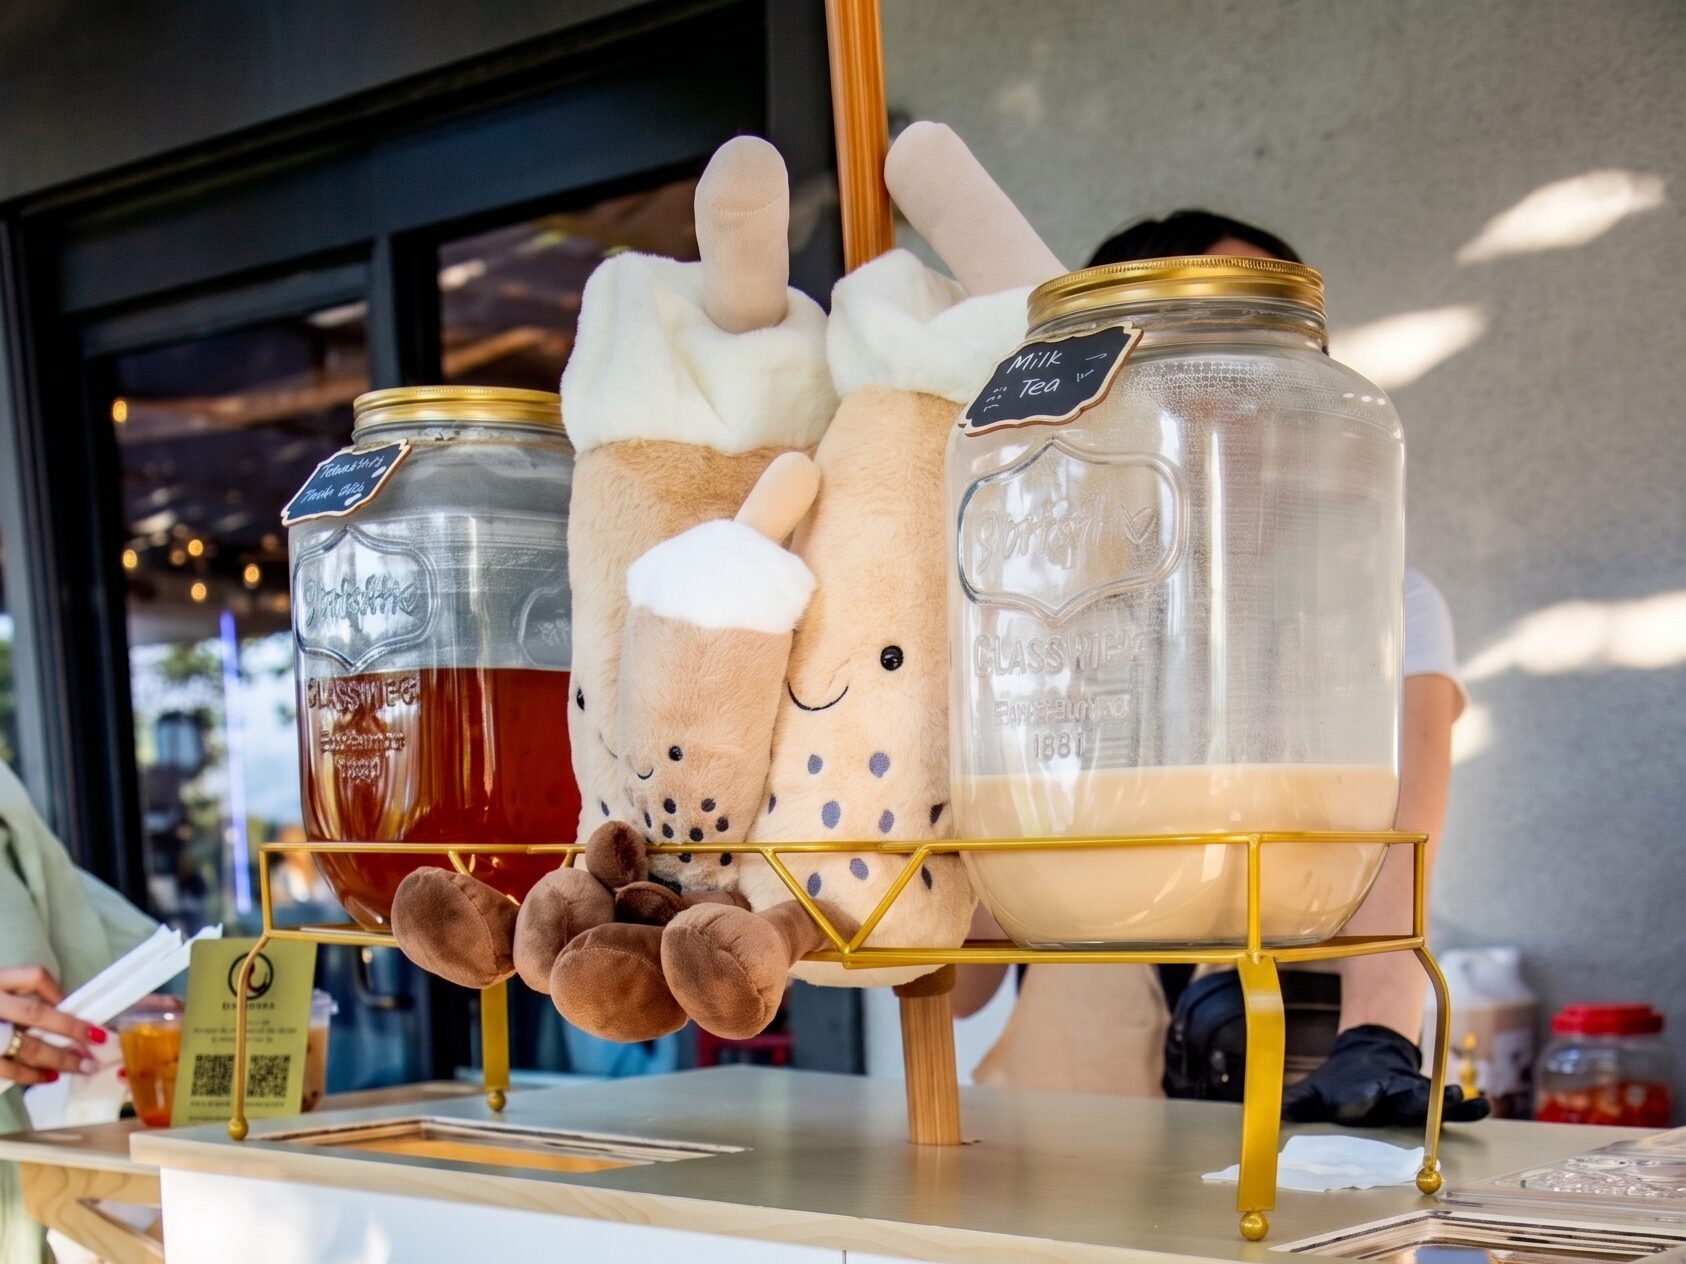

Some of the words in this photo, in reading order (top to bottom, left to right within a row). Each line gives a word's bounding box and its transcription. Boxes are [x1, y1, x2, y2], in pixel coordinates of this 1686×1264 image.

[1006, 350, 1063, 374] Milk
[1019, 378, 1061, 398] Tea
[1033, 729, 1086, 762] 1881
